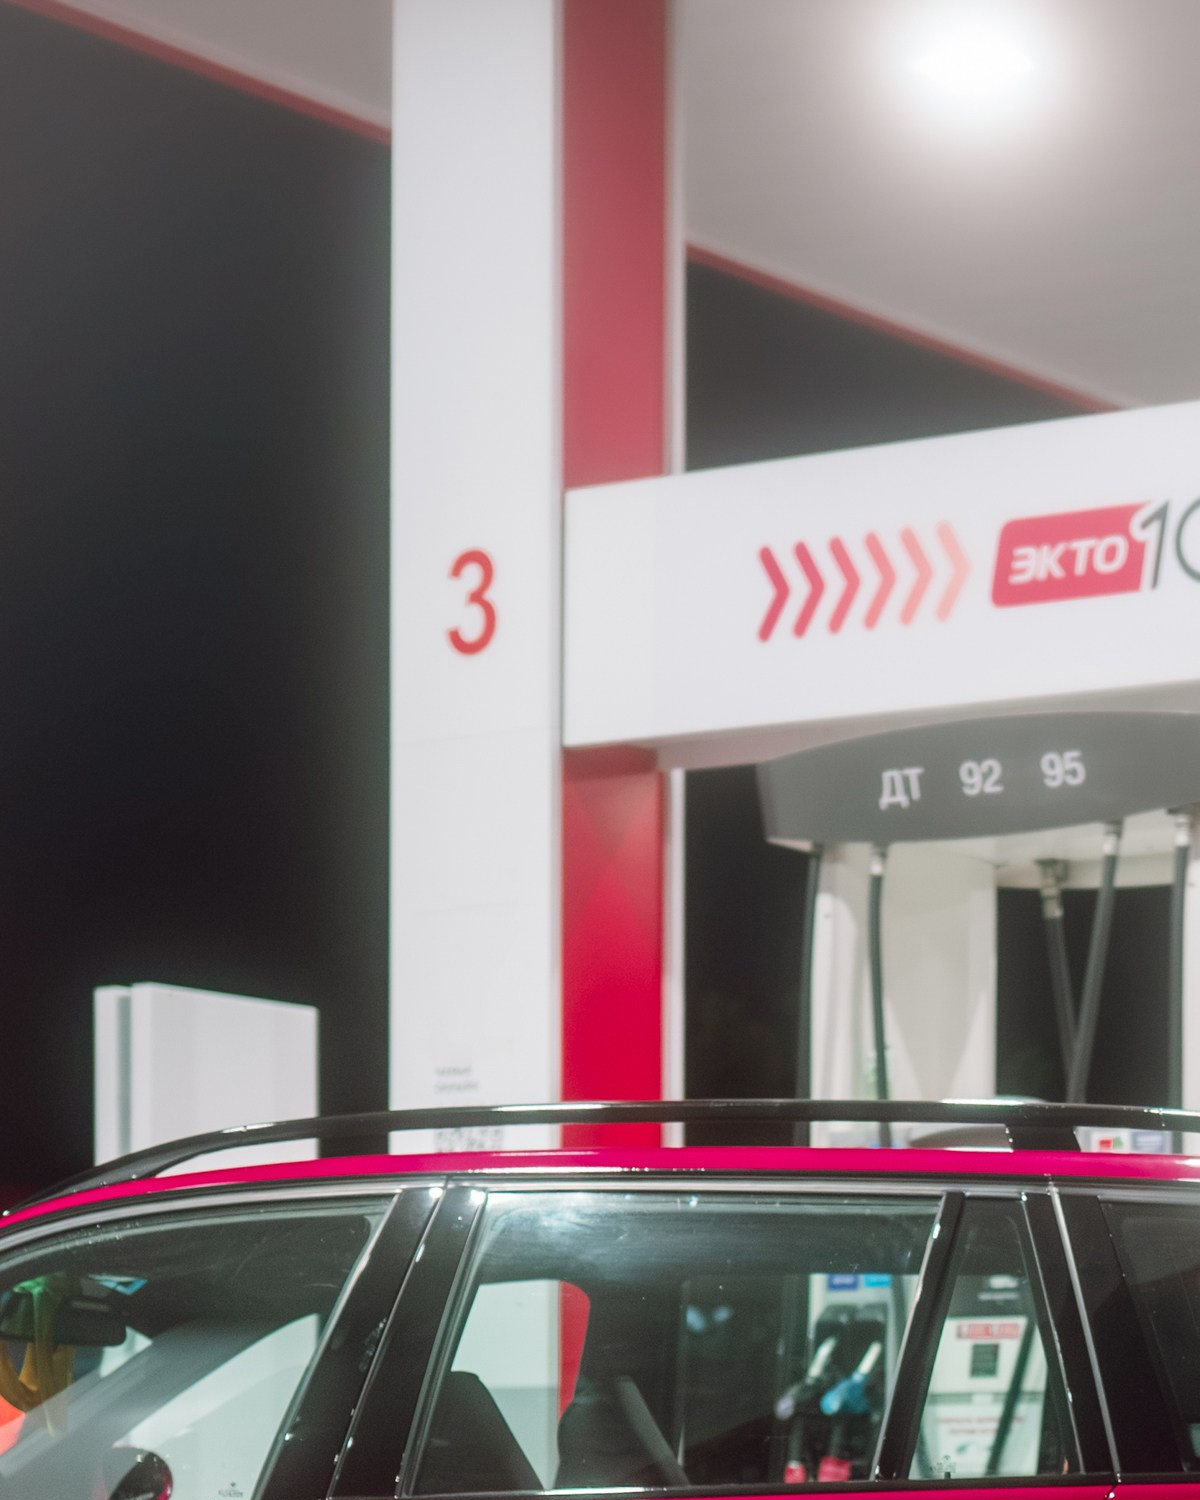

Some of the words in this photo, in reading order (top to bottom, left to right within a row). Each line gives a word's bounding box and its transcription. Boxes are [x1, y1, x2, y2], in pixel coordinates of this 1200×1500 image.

[1007, 533, 1130, 586] ЭКТО
[447, 547, 497, 655] 3
[879, 767, 925, 811] ДТ
[959, 758, 1004, 796] 92
[1041, 751, 1086, 788] 95
